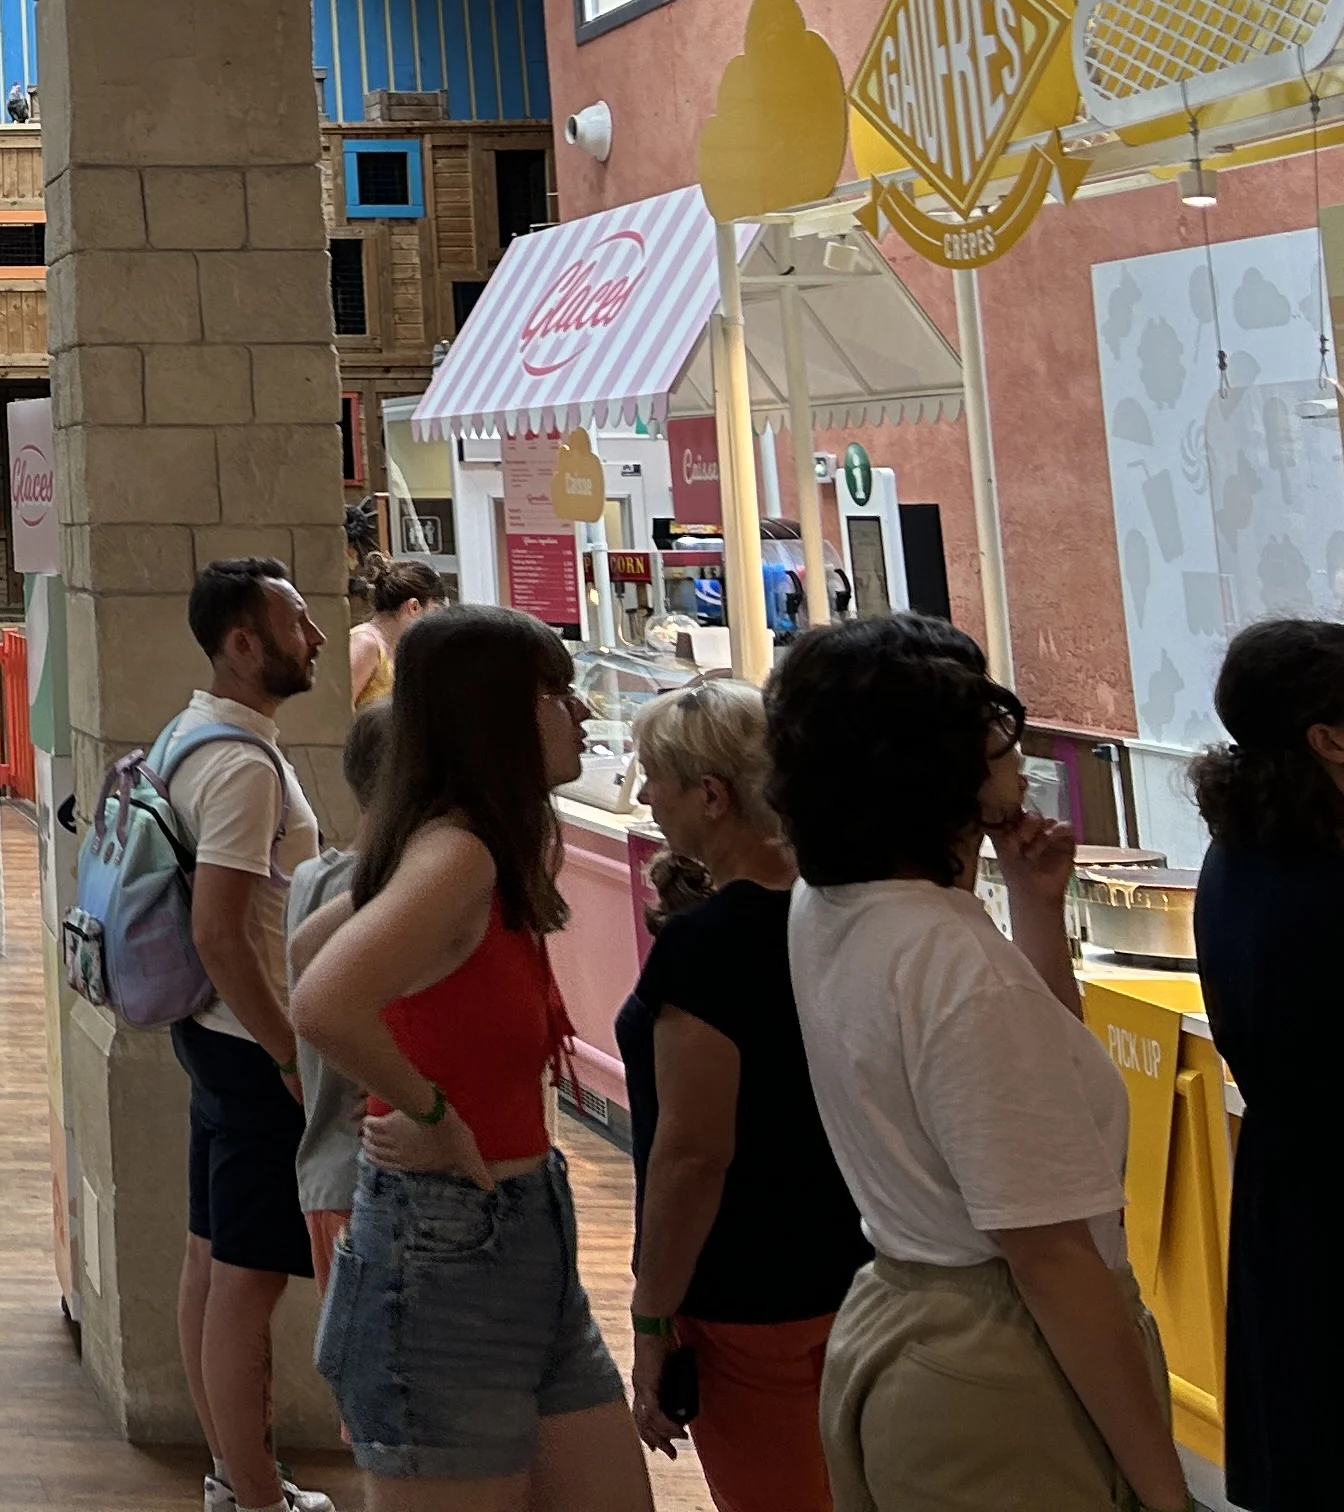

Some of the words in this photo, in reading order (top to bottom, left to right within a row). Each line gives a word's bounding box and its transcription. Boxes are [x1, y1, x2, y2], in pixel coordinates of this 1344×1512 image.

[943, 225, 996, 260] CRÊPES
[520, 259, 647, 353] Glaces
[10, 456, 54, 509] Glaces
[1107, 1023, 1140, 1073] PICK
[1141, 1038, 1161, 1079] UP
